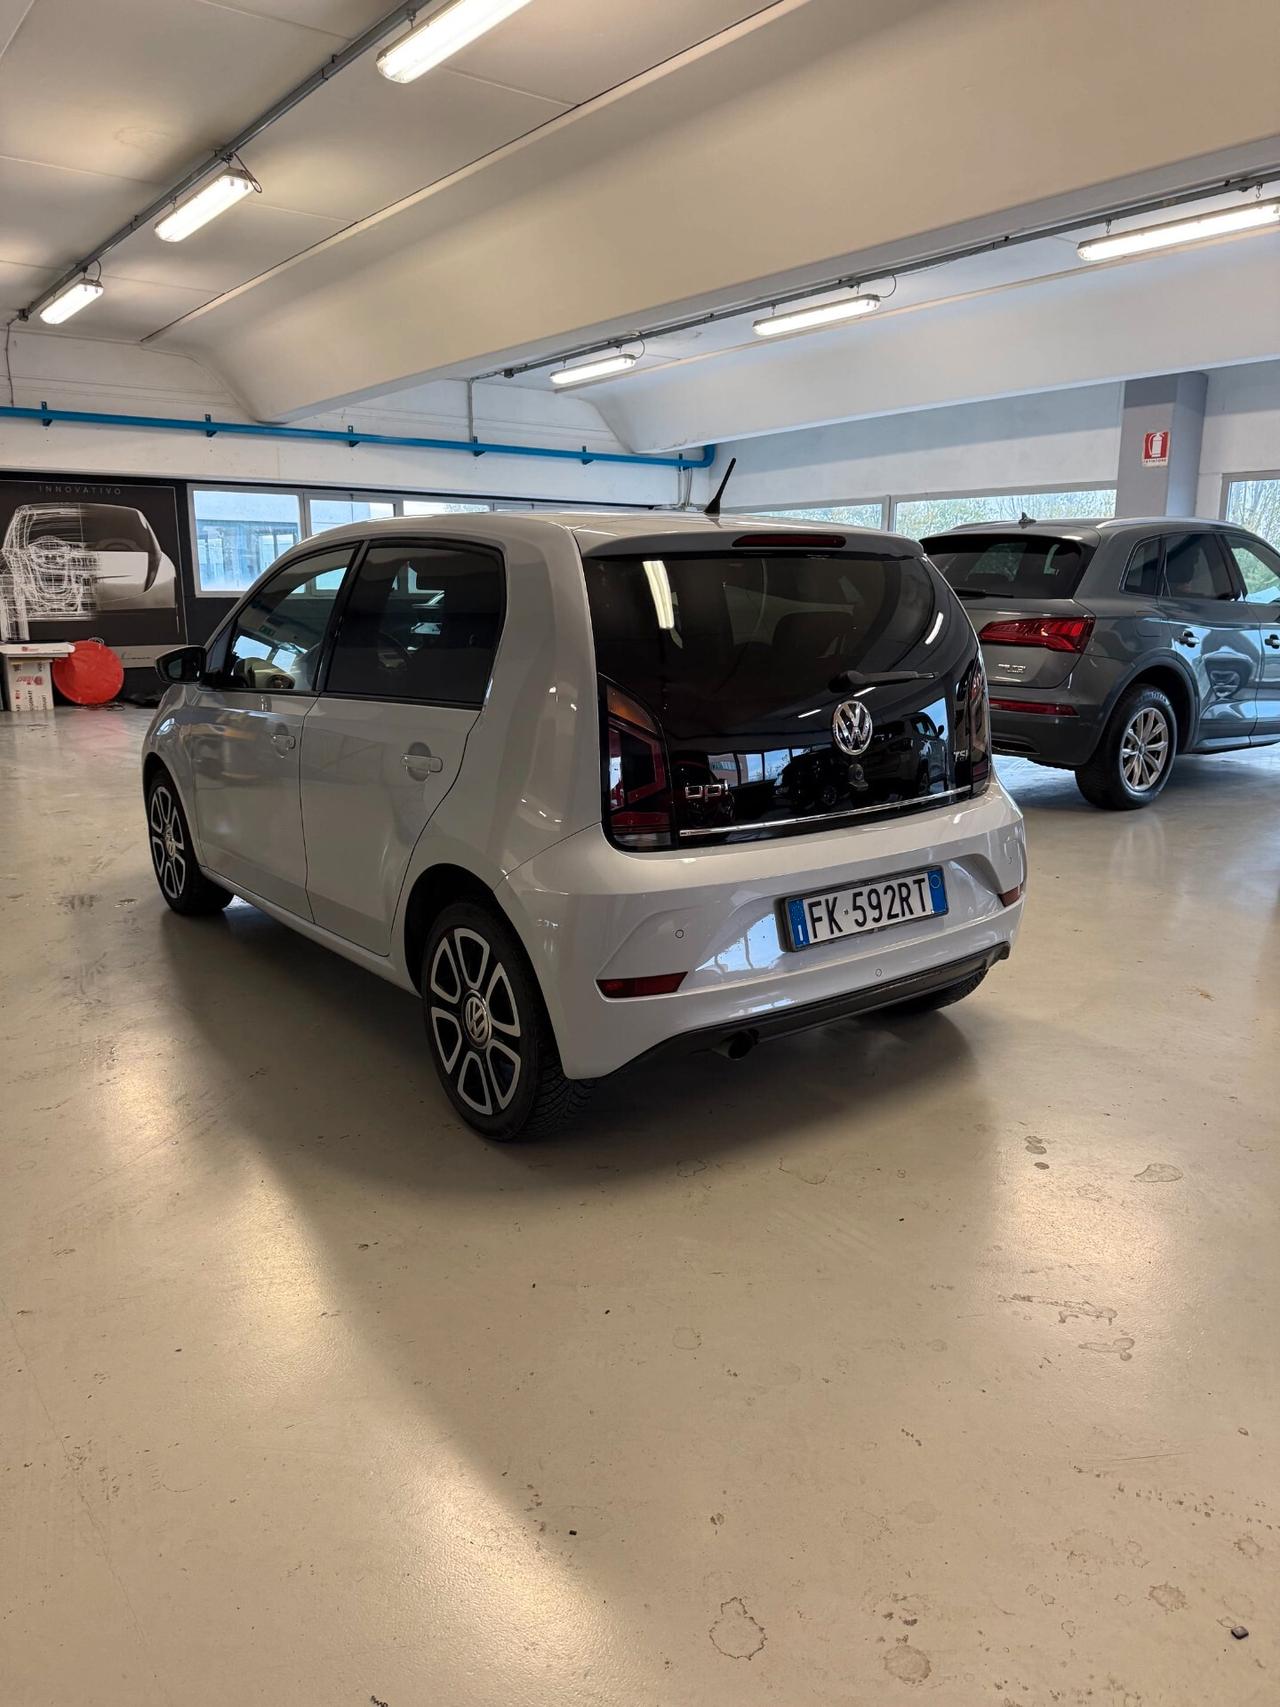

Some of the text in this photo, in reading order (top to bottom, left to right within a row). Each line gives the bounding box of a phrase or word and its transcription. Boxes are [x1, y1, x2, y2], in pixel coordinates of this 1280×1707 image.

[38, 485, 122, 496] INNOVATIVO
[807, 895, 843, 939] FK
[852, 877, 927, 928] 592RT
